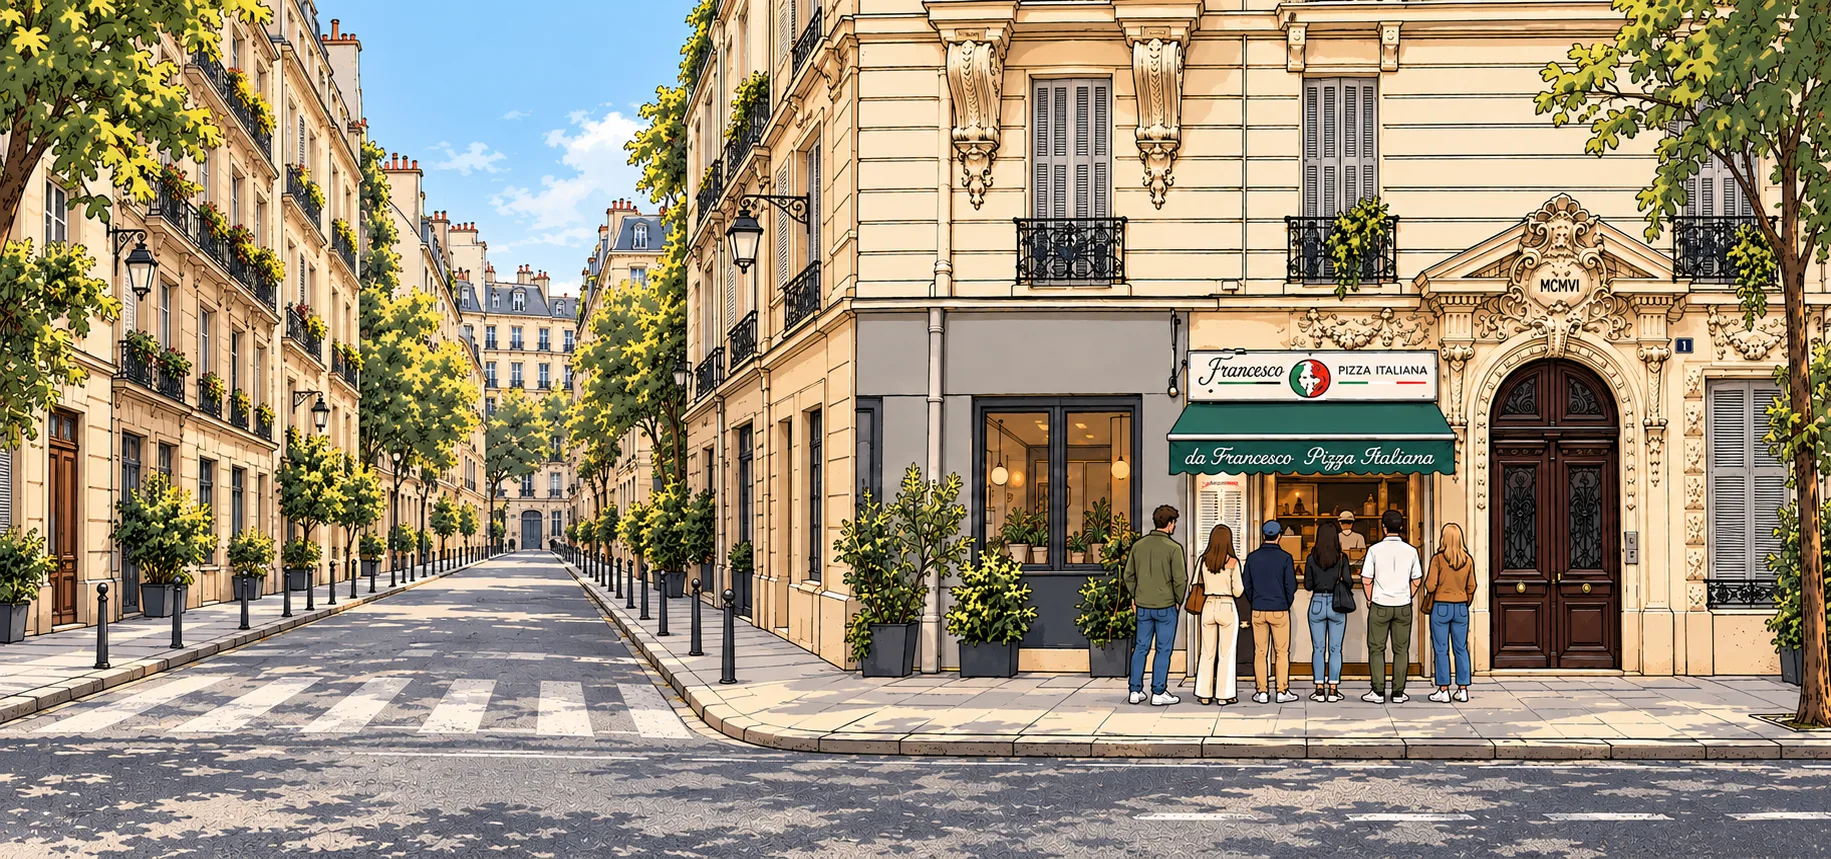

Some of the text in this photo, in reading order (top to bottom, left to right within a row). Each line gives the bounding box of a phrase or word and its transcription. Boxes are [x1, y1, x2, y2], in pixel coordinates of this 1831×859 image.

[1540, 279, 1580, 293] MCMVI
[1681, 341, 1687, 351] 1
[1198, 356, 1285, 386] Francesco
[1338, 365, 1428, 376] PIZZA ITALIANA
[1185, 448, 1206, 465] da
[1303, 447, 1356, 470] Pizza
[1360, 447, 1435, 465] Italiana
